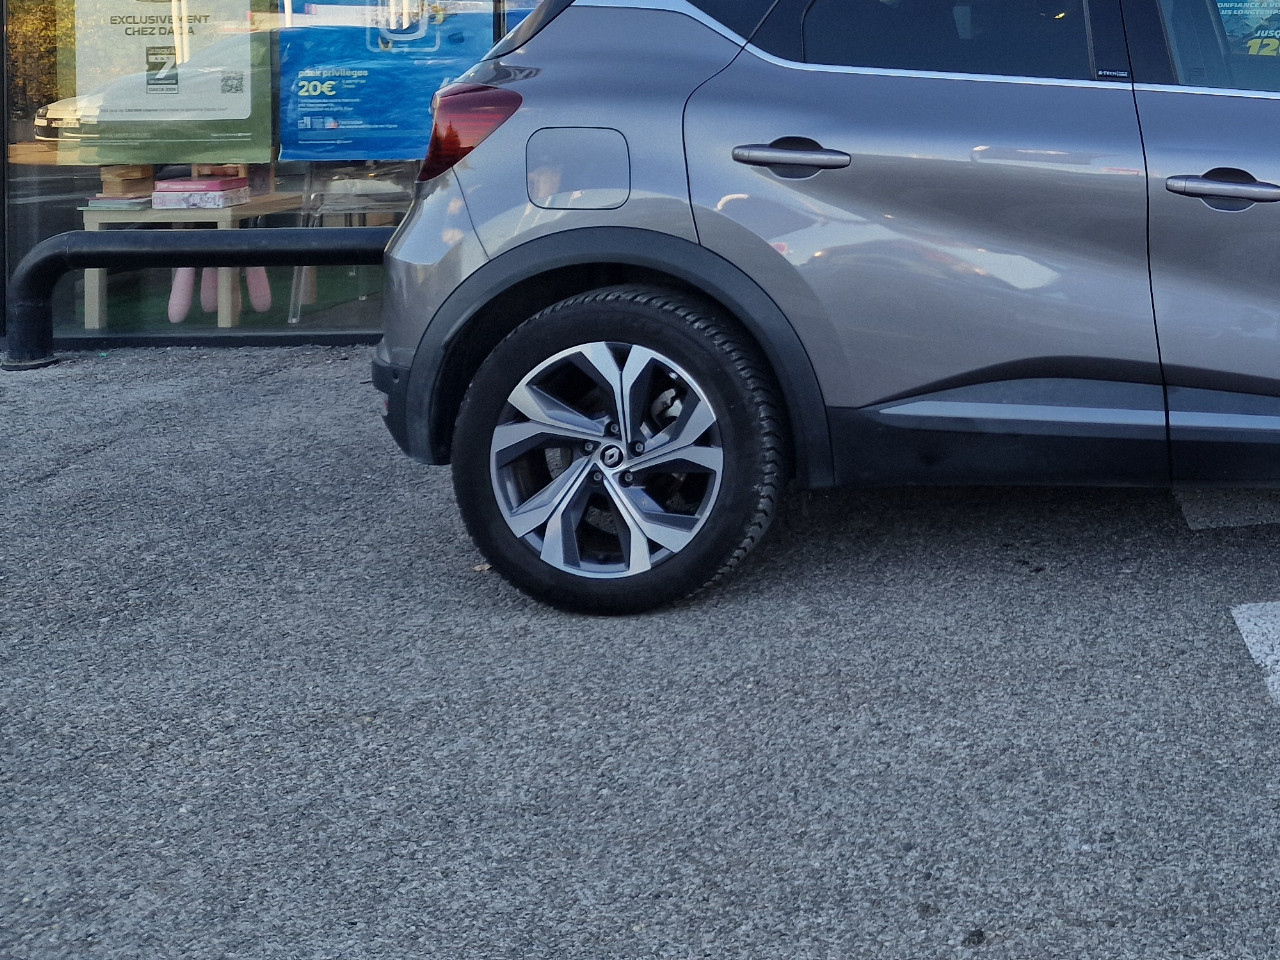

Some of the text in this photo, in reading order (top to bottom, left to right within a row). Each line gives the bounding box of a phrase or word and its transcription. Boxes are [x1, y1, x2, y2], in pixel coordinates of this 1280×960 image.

[110, 14, 210, 25] EXCLUSIVEENT
[125, 26, 195, 36] CHEZ DAA
[298, 80, 337, 96] 20€
